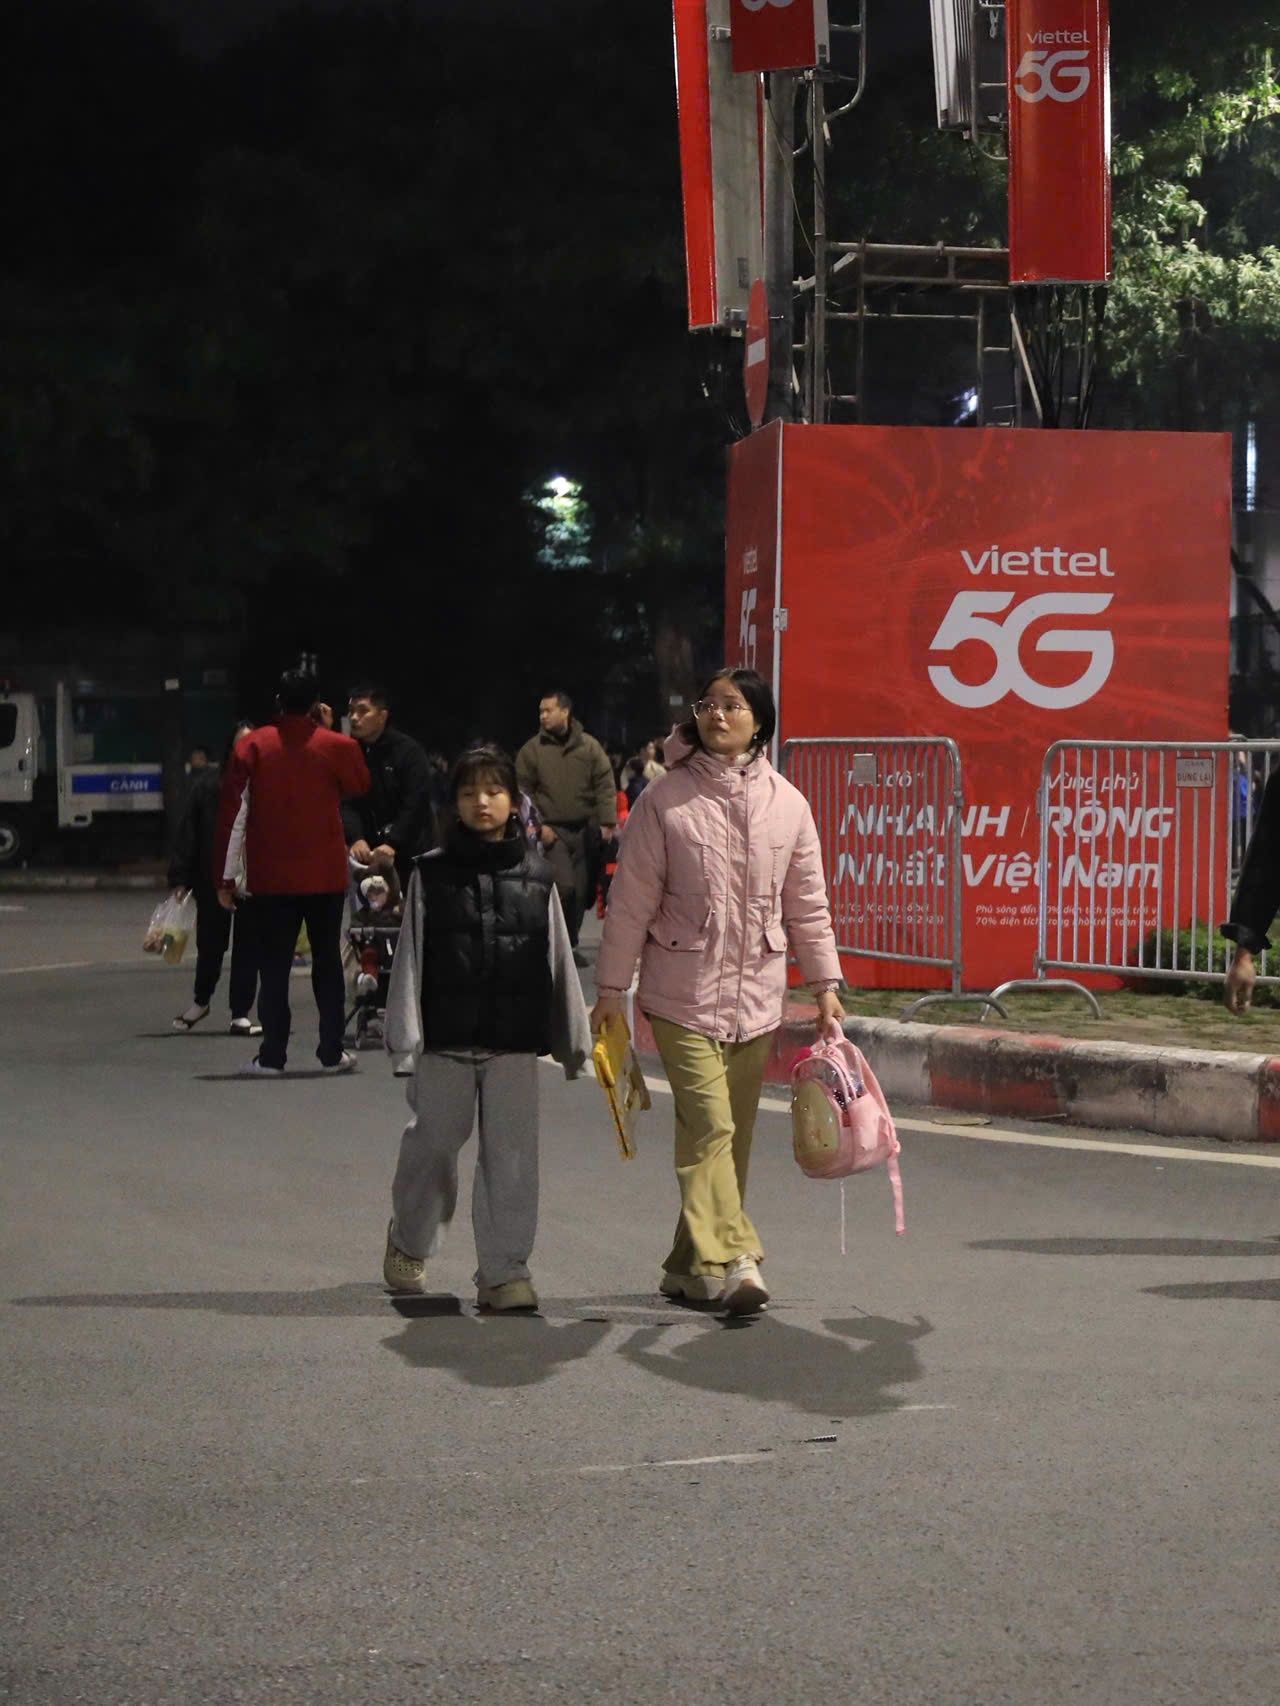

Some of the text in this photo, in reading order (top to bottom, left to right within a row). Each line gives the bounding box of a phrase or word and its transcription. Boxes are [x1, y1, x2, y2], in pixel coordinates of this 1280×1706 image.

[1026, 29, 1090, 44] viettel
[1014, 50, 1091, 104] 5G
[960, 545, 1115, 577] viettel
[928, 590, 1115, 710] 5G
[1101, 771, 1139, 793] phủ
[840, 803, 1010, 837] NHANH
[1048, 800, 1174, 843] RỘNG
[833, 847, 1161, 894] Nhất Việt Nam
[975, 917, 997, 927] 70%
